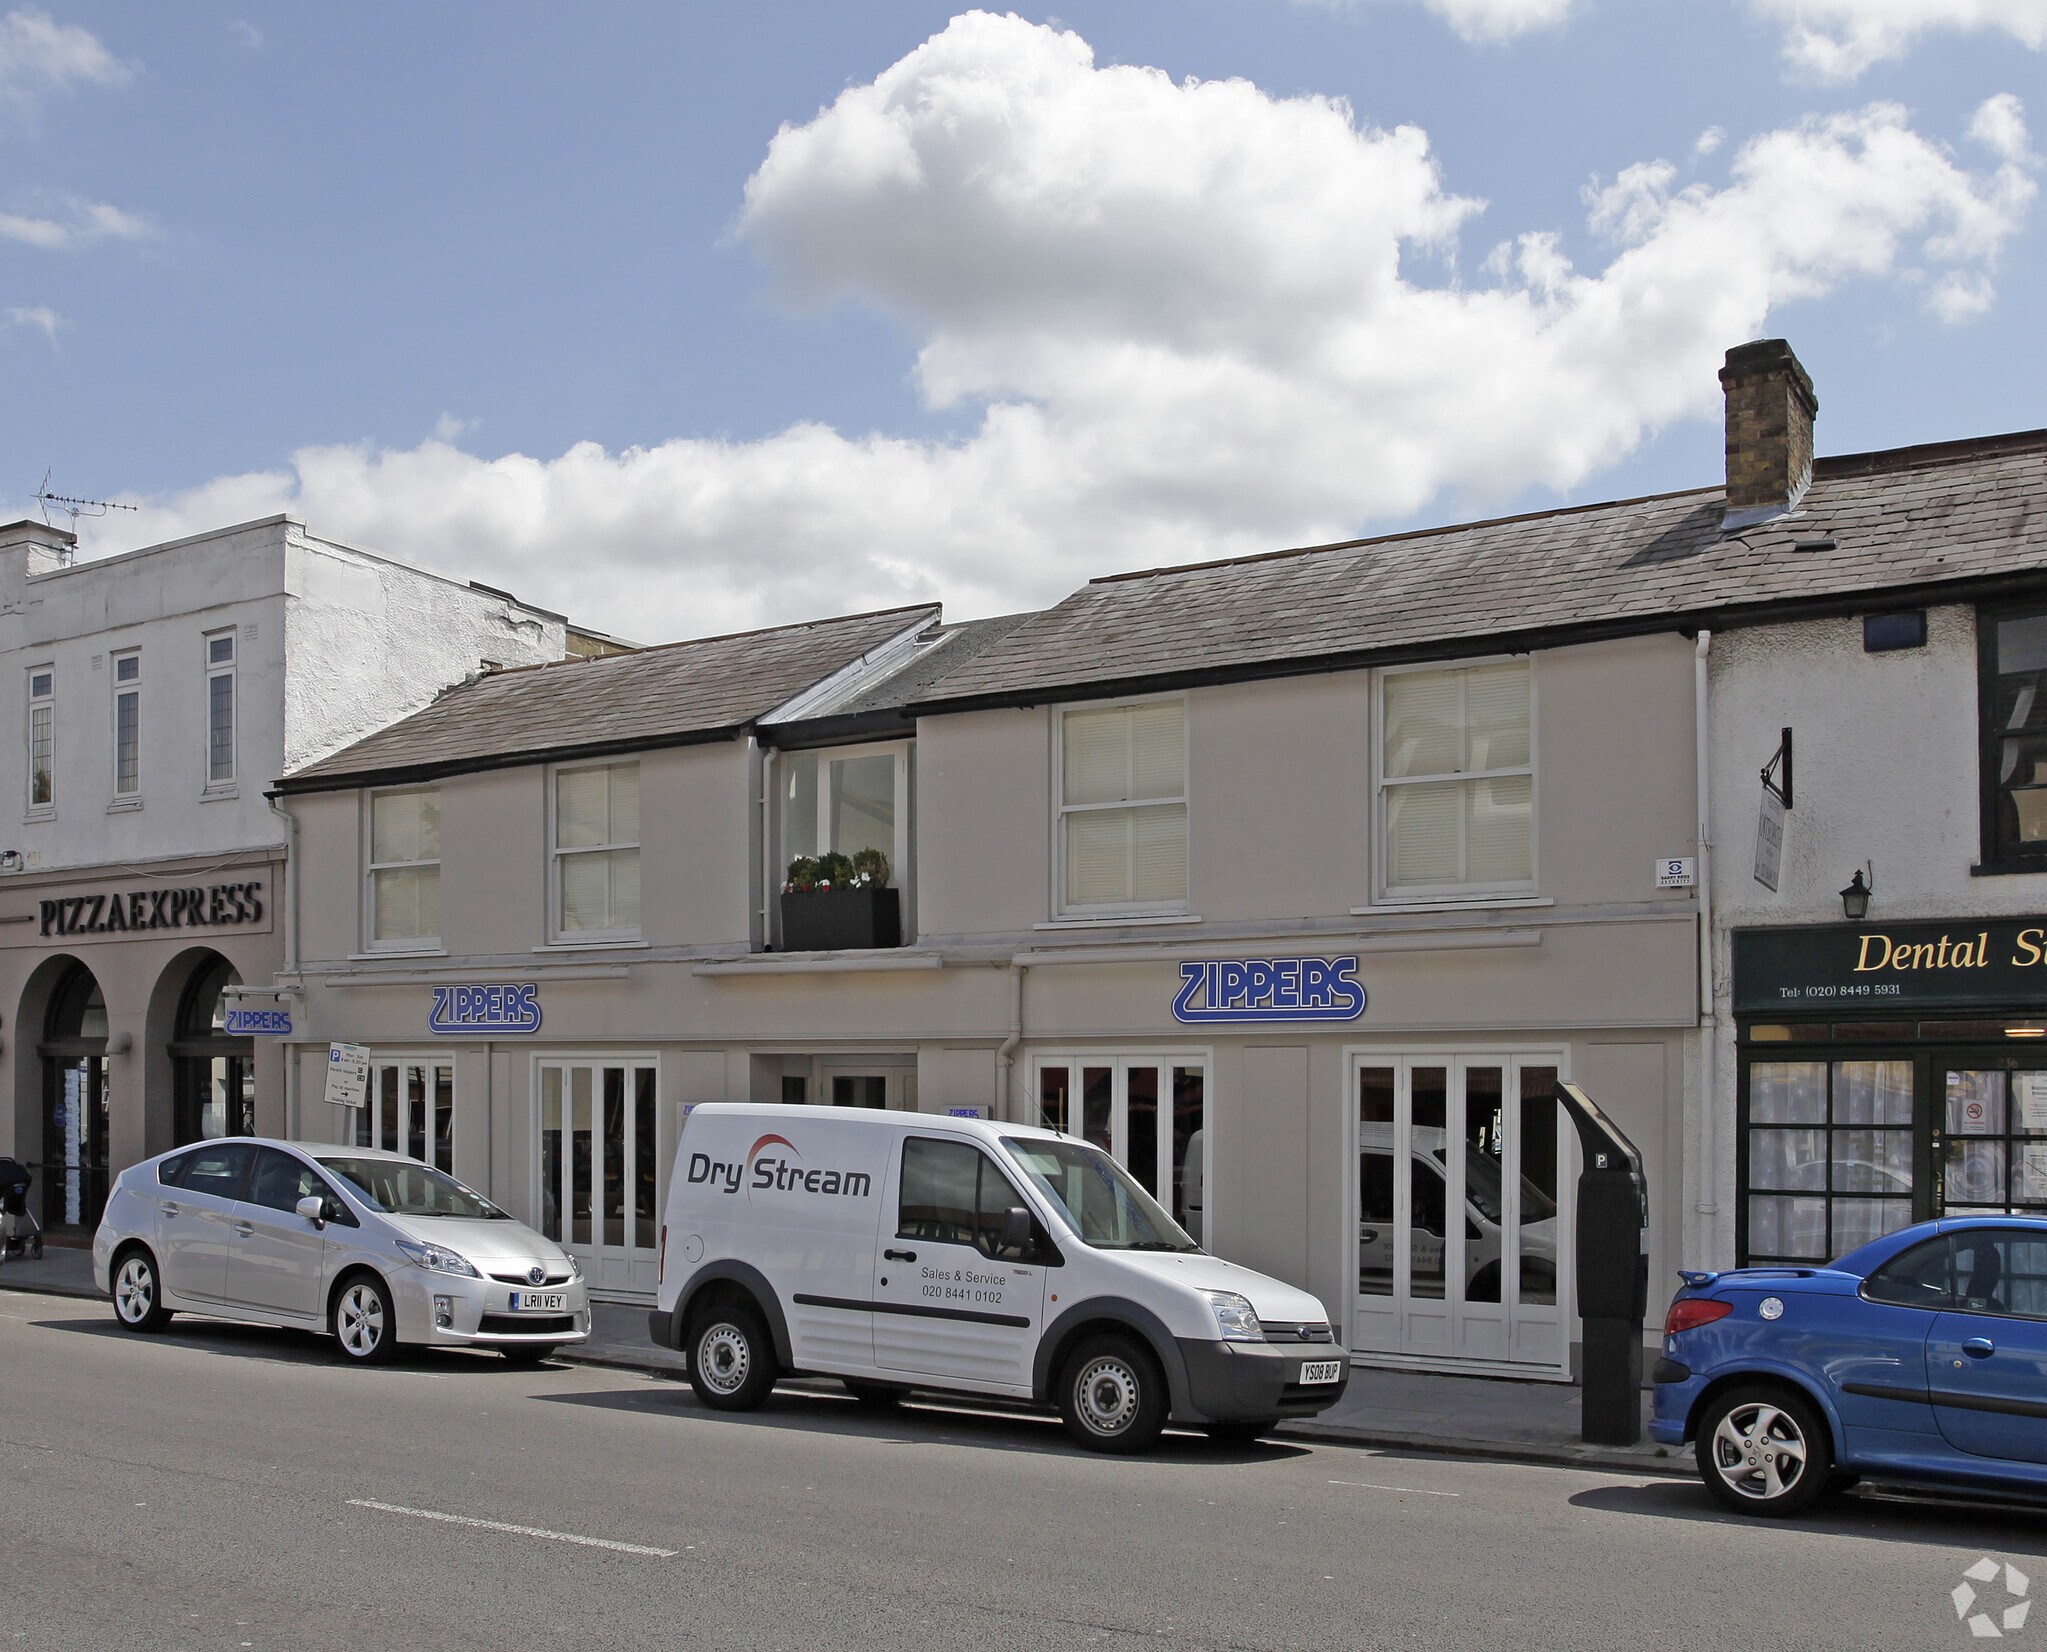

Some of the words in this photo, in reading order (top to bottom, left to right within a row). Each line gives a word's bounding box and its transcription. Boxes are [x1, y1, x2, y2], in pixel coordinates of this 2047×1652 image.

[39, 881, 262, 936] PIZZAEXPRESS
[1853, 932, 1989, 972] Dental
[2011, 928, 2047, 967] S
[1172, 957, 1366, 1023] ZIPPERS
[1780, 987, 1801, 998] Tel:
[1805, 985, 1837, 998] (020)
[1840, 985, 1870, 996] 8449
[1874, 984, 1901, 995] 5931
[226, 1010, 293, 1035] ZIPPERS
[428, 984, 541, 1033] ZIPPERS
[688, 1153, 743, 1194] Dry
[752, 1158, 871, 1197] Stream
[921, 1267, 951, 1280] Sales
[954, 1270, 961, 1281] &
[965, 1271, 1006, 1286] Service
[524, 1294, 542, 1308] LR11
[544, 1294, 562, 1308] VEY
[922, 1285, 942, 1298] 020
[945, 1287, 970, 1301] 8441
[975, 1290, 1002, 1304] 0102
